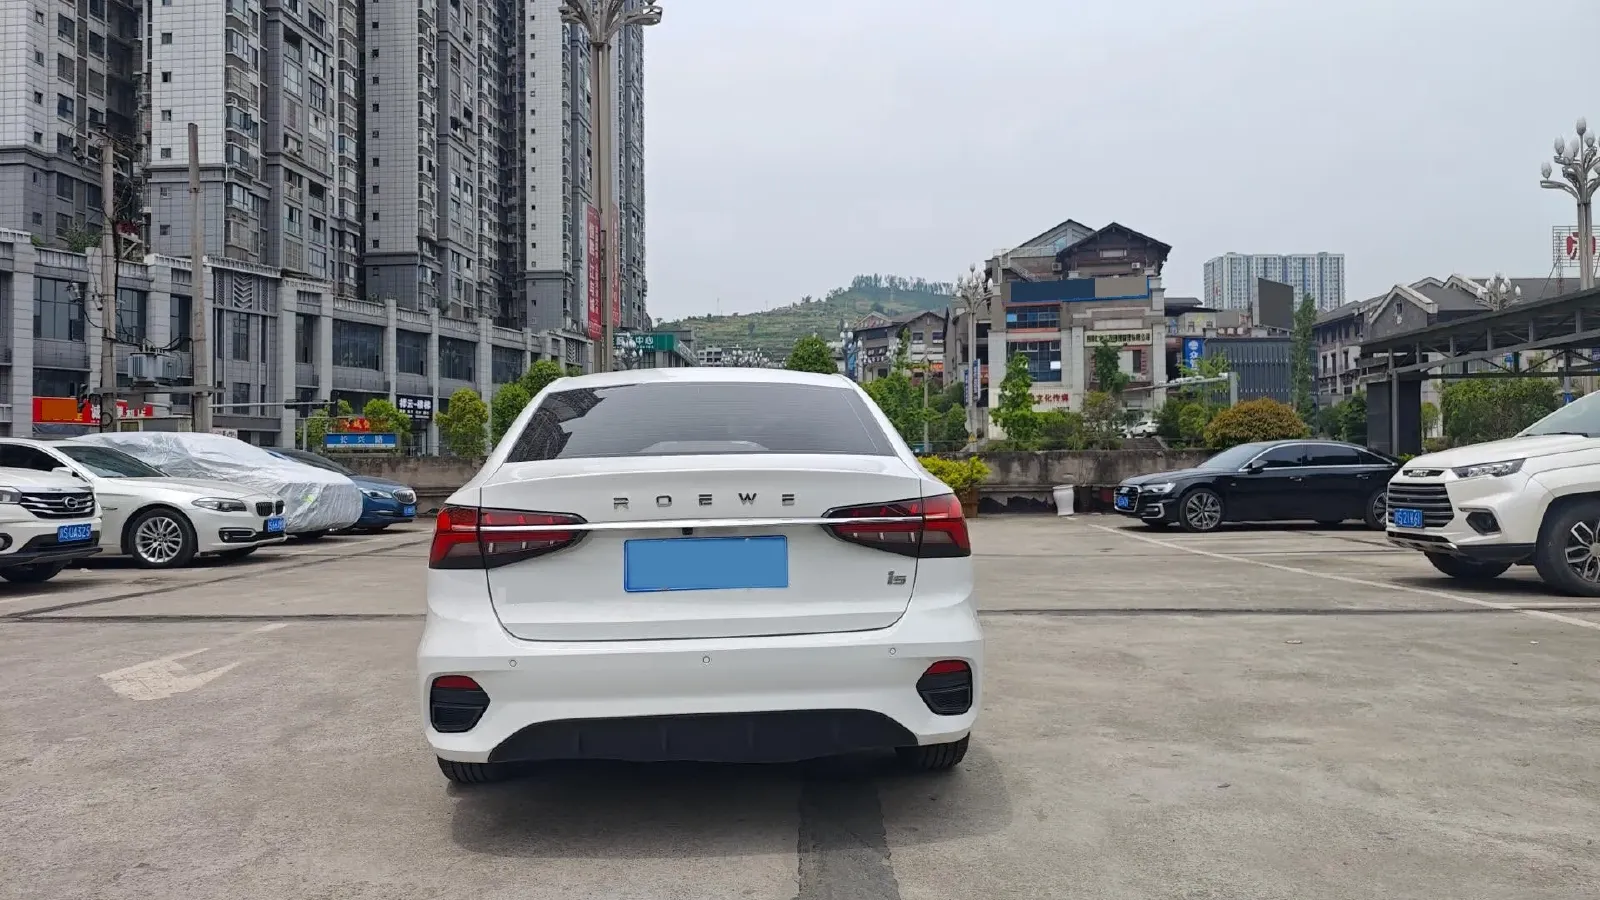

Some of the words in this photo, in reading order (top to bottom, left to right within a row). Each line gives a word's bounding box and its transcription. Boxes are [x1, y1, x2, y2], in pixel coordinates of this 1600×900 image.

[340, 435, 383, 444] 长兴路
[613, 492, 795, 510] ROEWE
